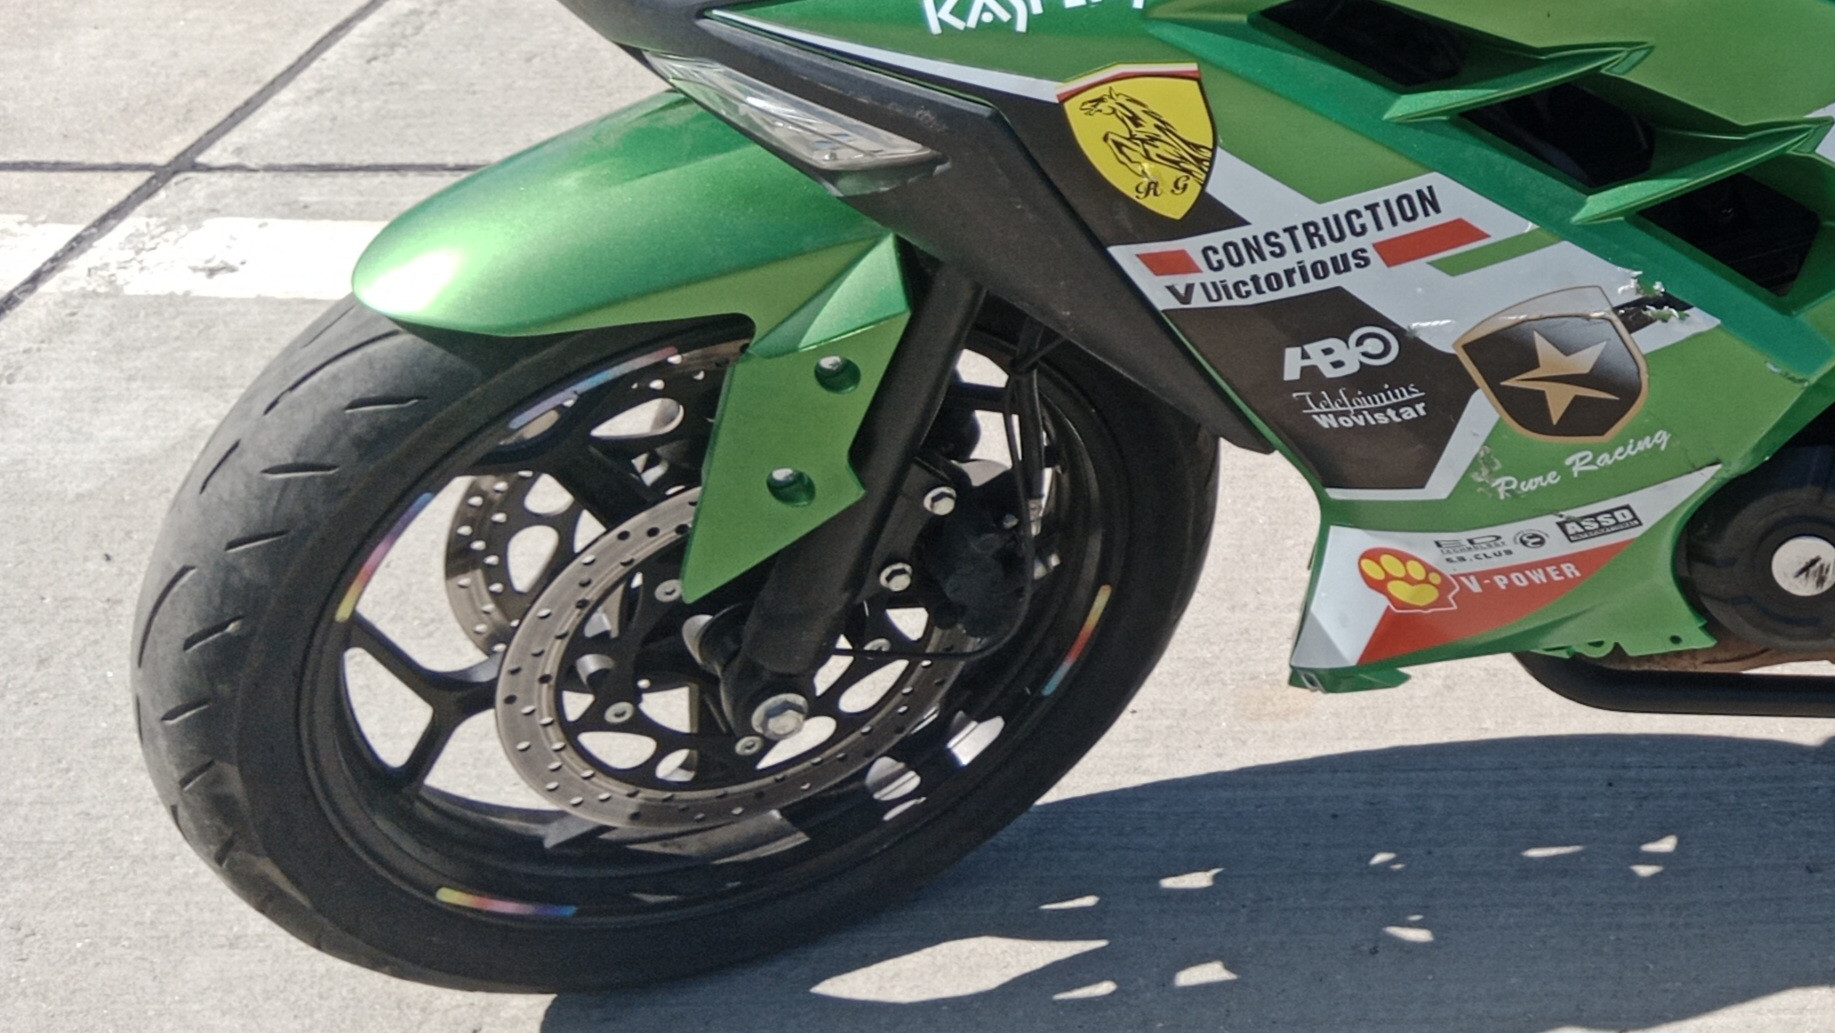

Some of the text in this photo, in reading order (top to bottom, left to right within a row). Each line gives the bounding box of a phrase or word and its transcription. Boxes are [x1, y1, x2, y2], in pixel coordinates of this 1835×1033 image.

[1201, 185, 1442, 272] CONSTRUCTION
[1491, 429, 1671, 500] Pure Racing
[1459, 562, 1582, 594] V-POWER
